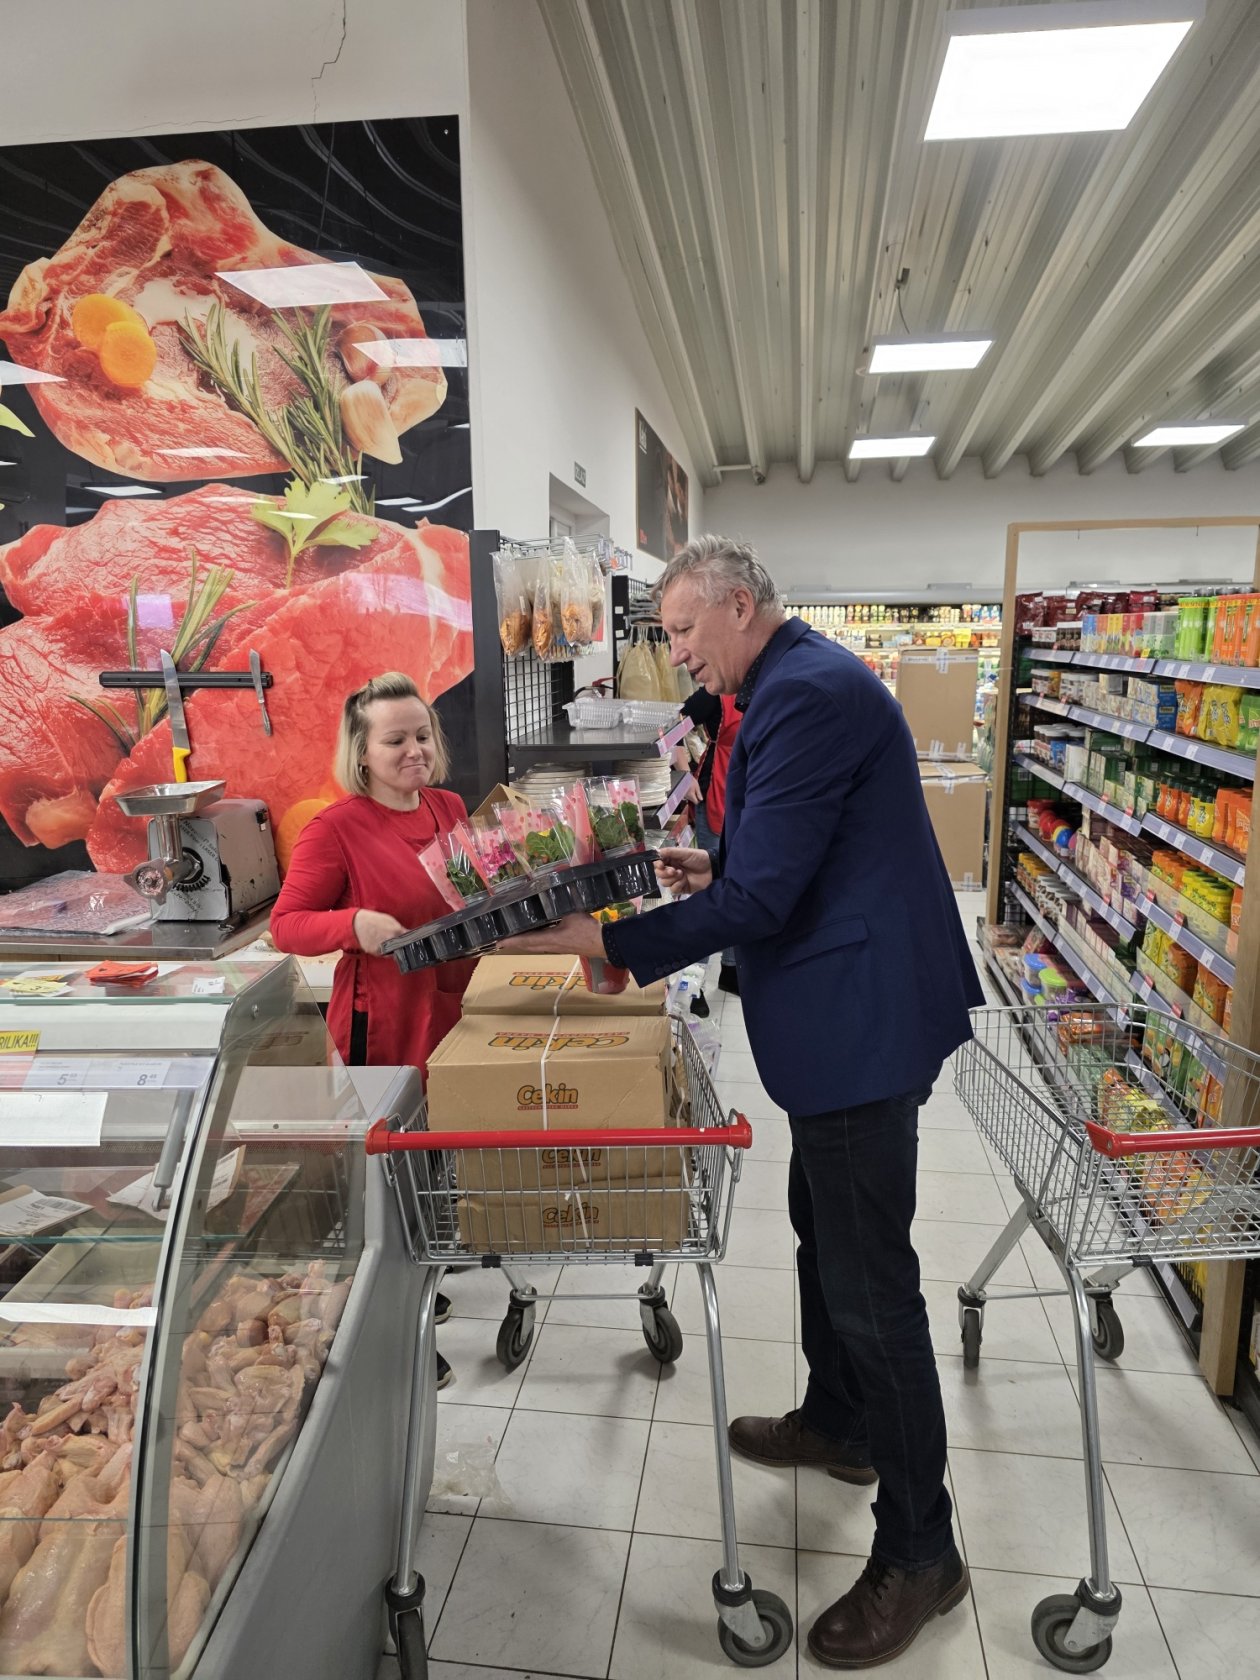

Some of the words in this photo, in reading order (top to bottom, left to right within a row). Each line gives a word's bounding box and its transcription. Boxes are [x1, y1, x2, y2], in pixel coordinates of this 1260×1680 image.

[488, 1036, 630, 1051] Cekin
[137, 1074, 147, 1085] 8
[517, 1083, 578, 1105] Cekin
